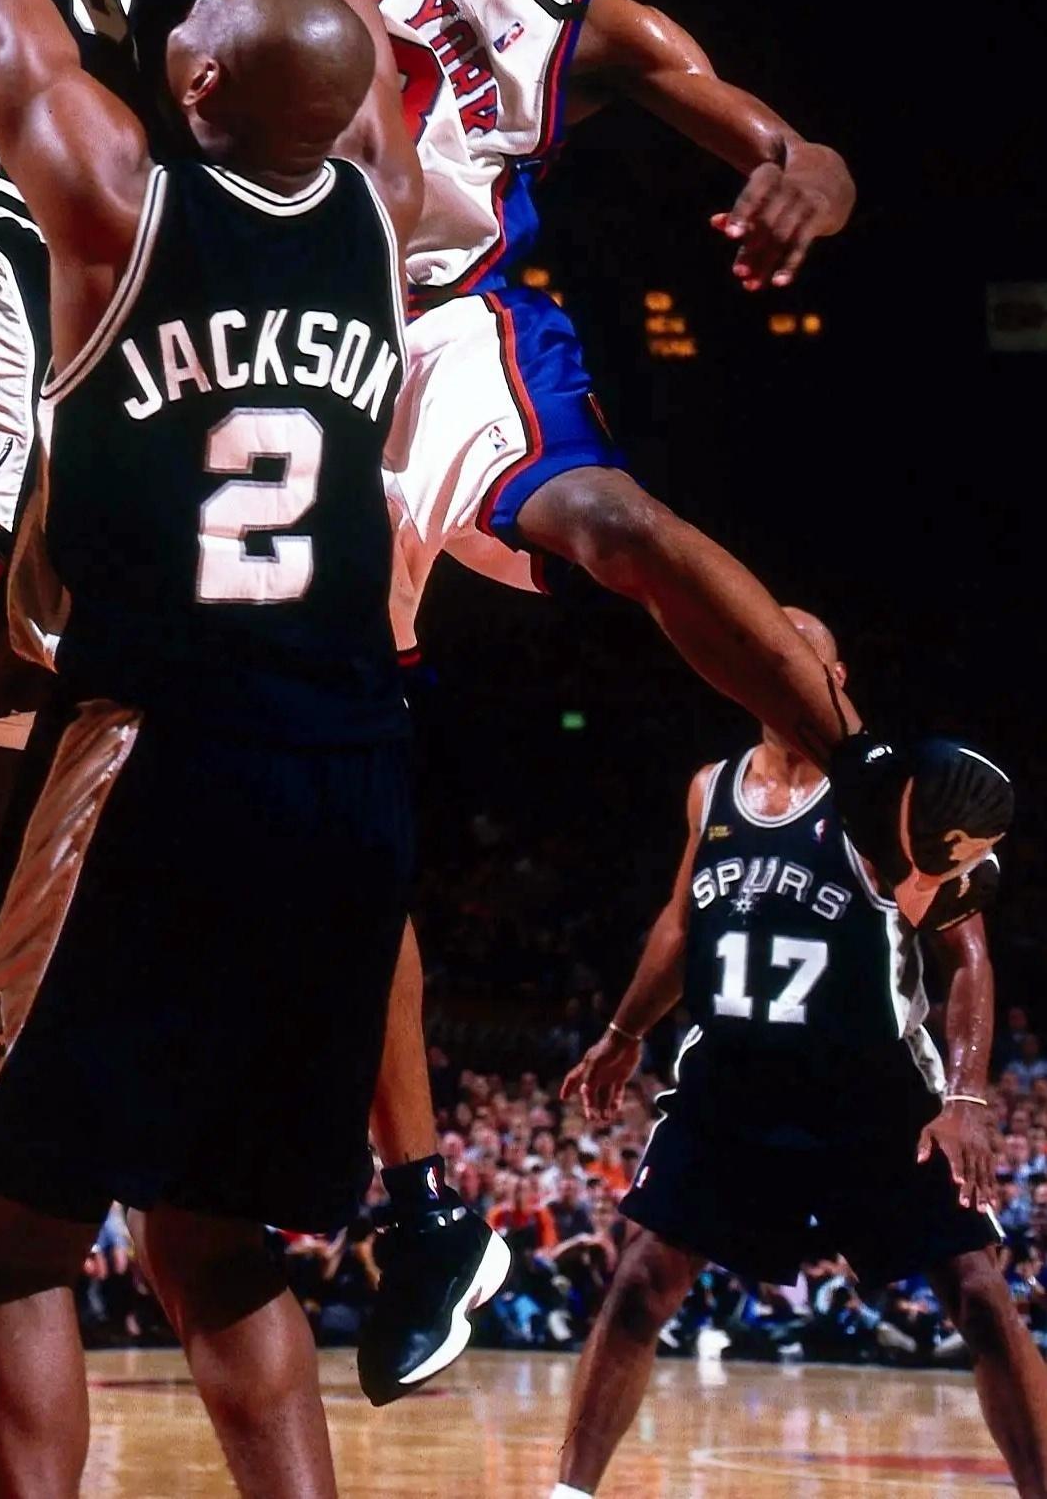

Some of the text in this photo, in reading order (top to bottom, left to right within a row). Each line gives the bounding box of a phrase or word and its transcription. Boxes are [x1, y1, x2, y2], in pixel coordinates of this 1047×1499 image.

[120, 308, 399, 423] JACKSON
[195, 406, 325, 606] 2
[692, 856, 853, 922] SPURS
[712, 930, 829, 1025] 17
